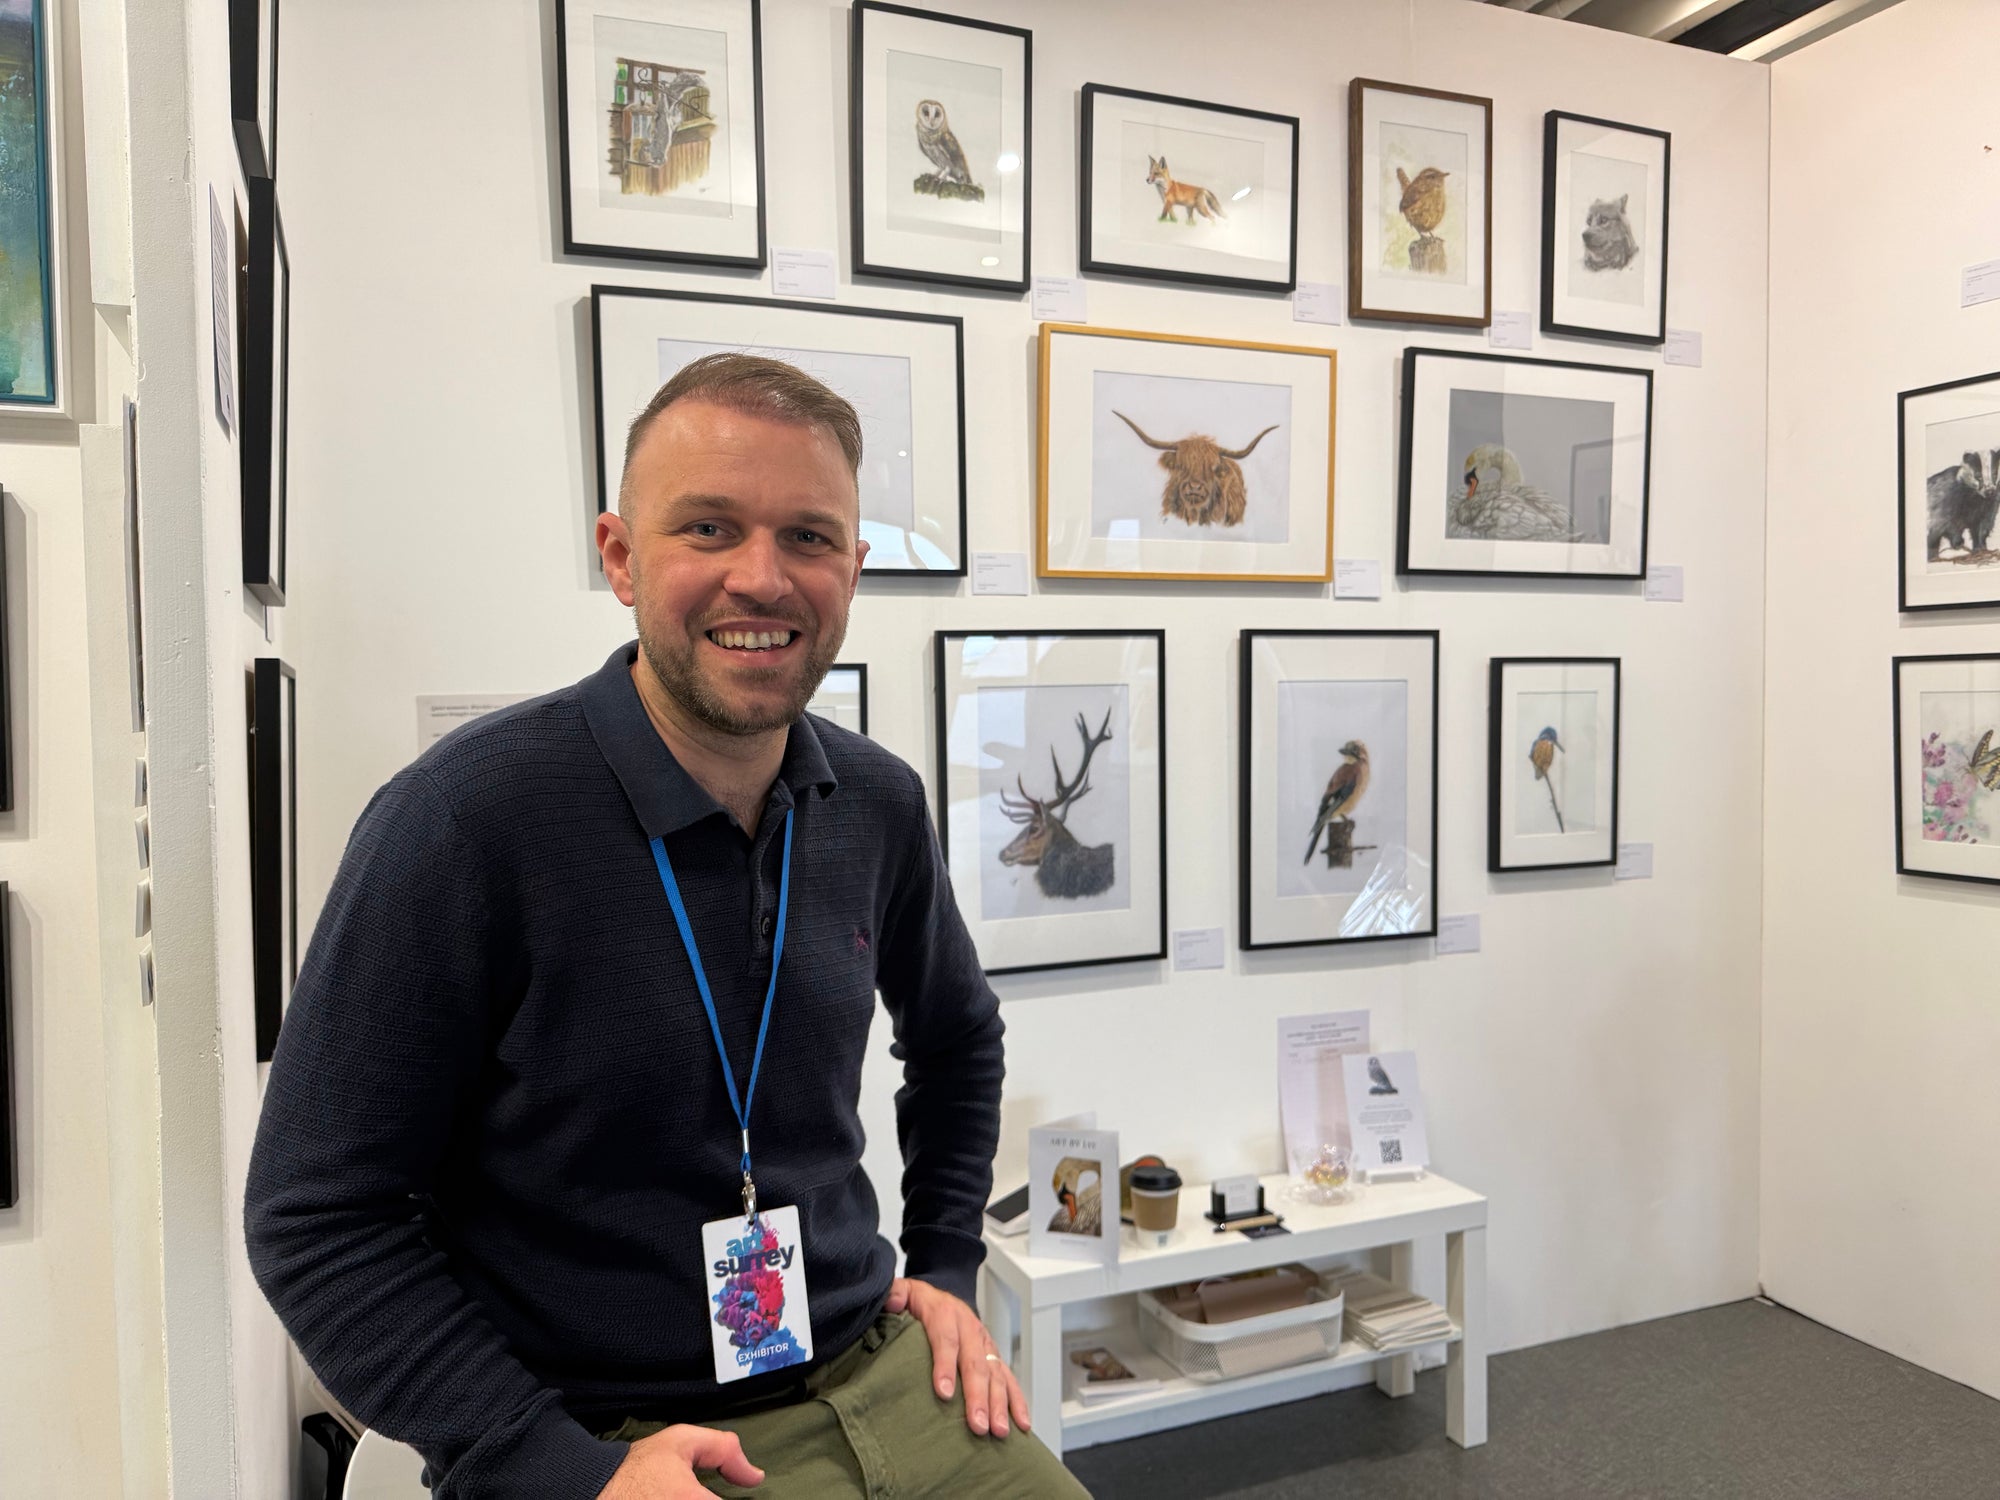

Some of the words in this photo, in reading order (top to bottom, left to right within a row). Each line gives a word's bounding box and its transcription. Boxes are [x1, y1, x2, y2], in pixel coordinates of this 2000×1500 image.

[726, 1231, 763, 1257] art
[713, 1244, 794, 1277] surrey
[738, 1342, 789, 1363] EXHIBITOR
